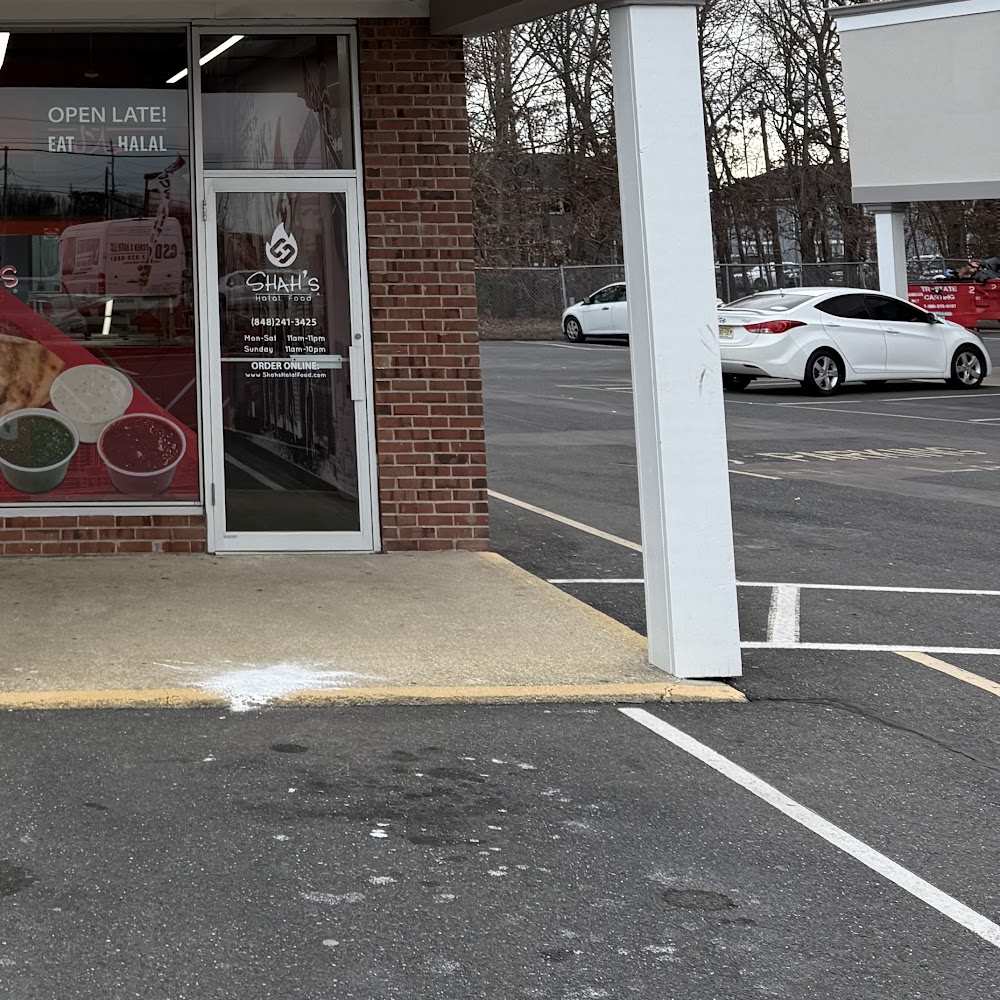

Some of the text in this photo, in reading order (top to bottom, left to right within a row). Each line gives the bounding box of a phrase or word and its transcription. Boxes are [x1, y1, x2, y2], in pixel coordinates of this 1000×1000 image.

[47, 106, 167, 123] OPEN LATE!
[48, 135, 75, 152] EAT
[118, 135, 167, 152] HALAL
[968, 286, 976, 294] 2
[251, 317, 317, 327] (848)241-3425
[286, 334, 326, 344] 11am-11pm
[243, 345, 326, 354] Sunday 11am-10pm
[251, 361, 320, 371] ORDER ONLINE:
